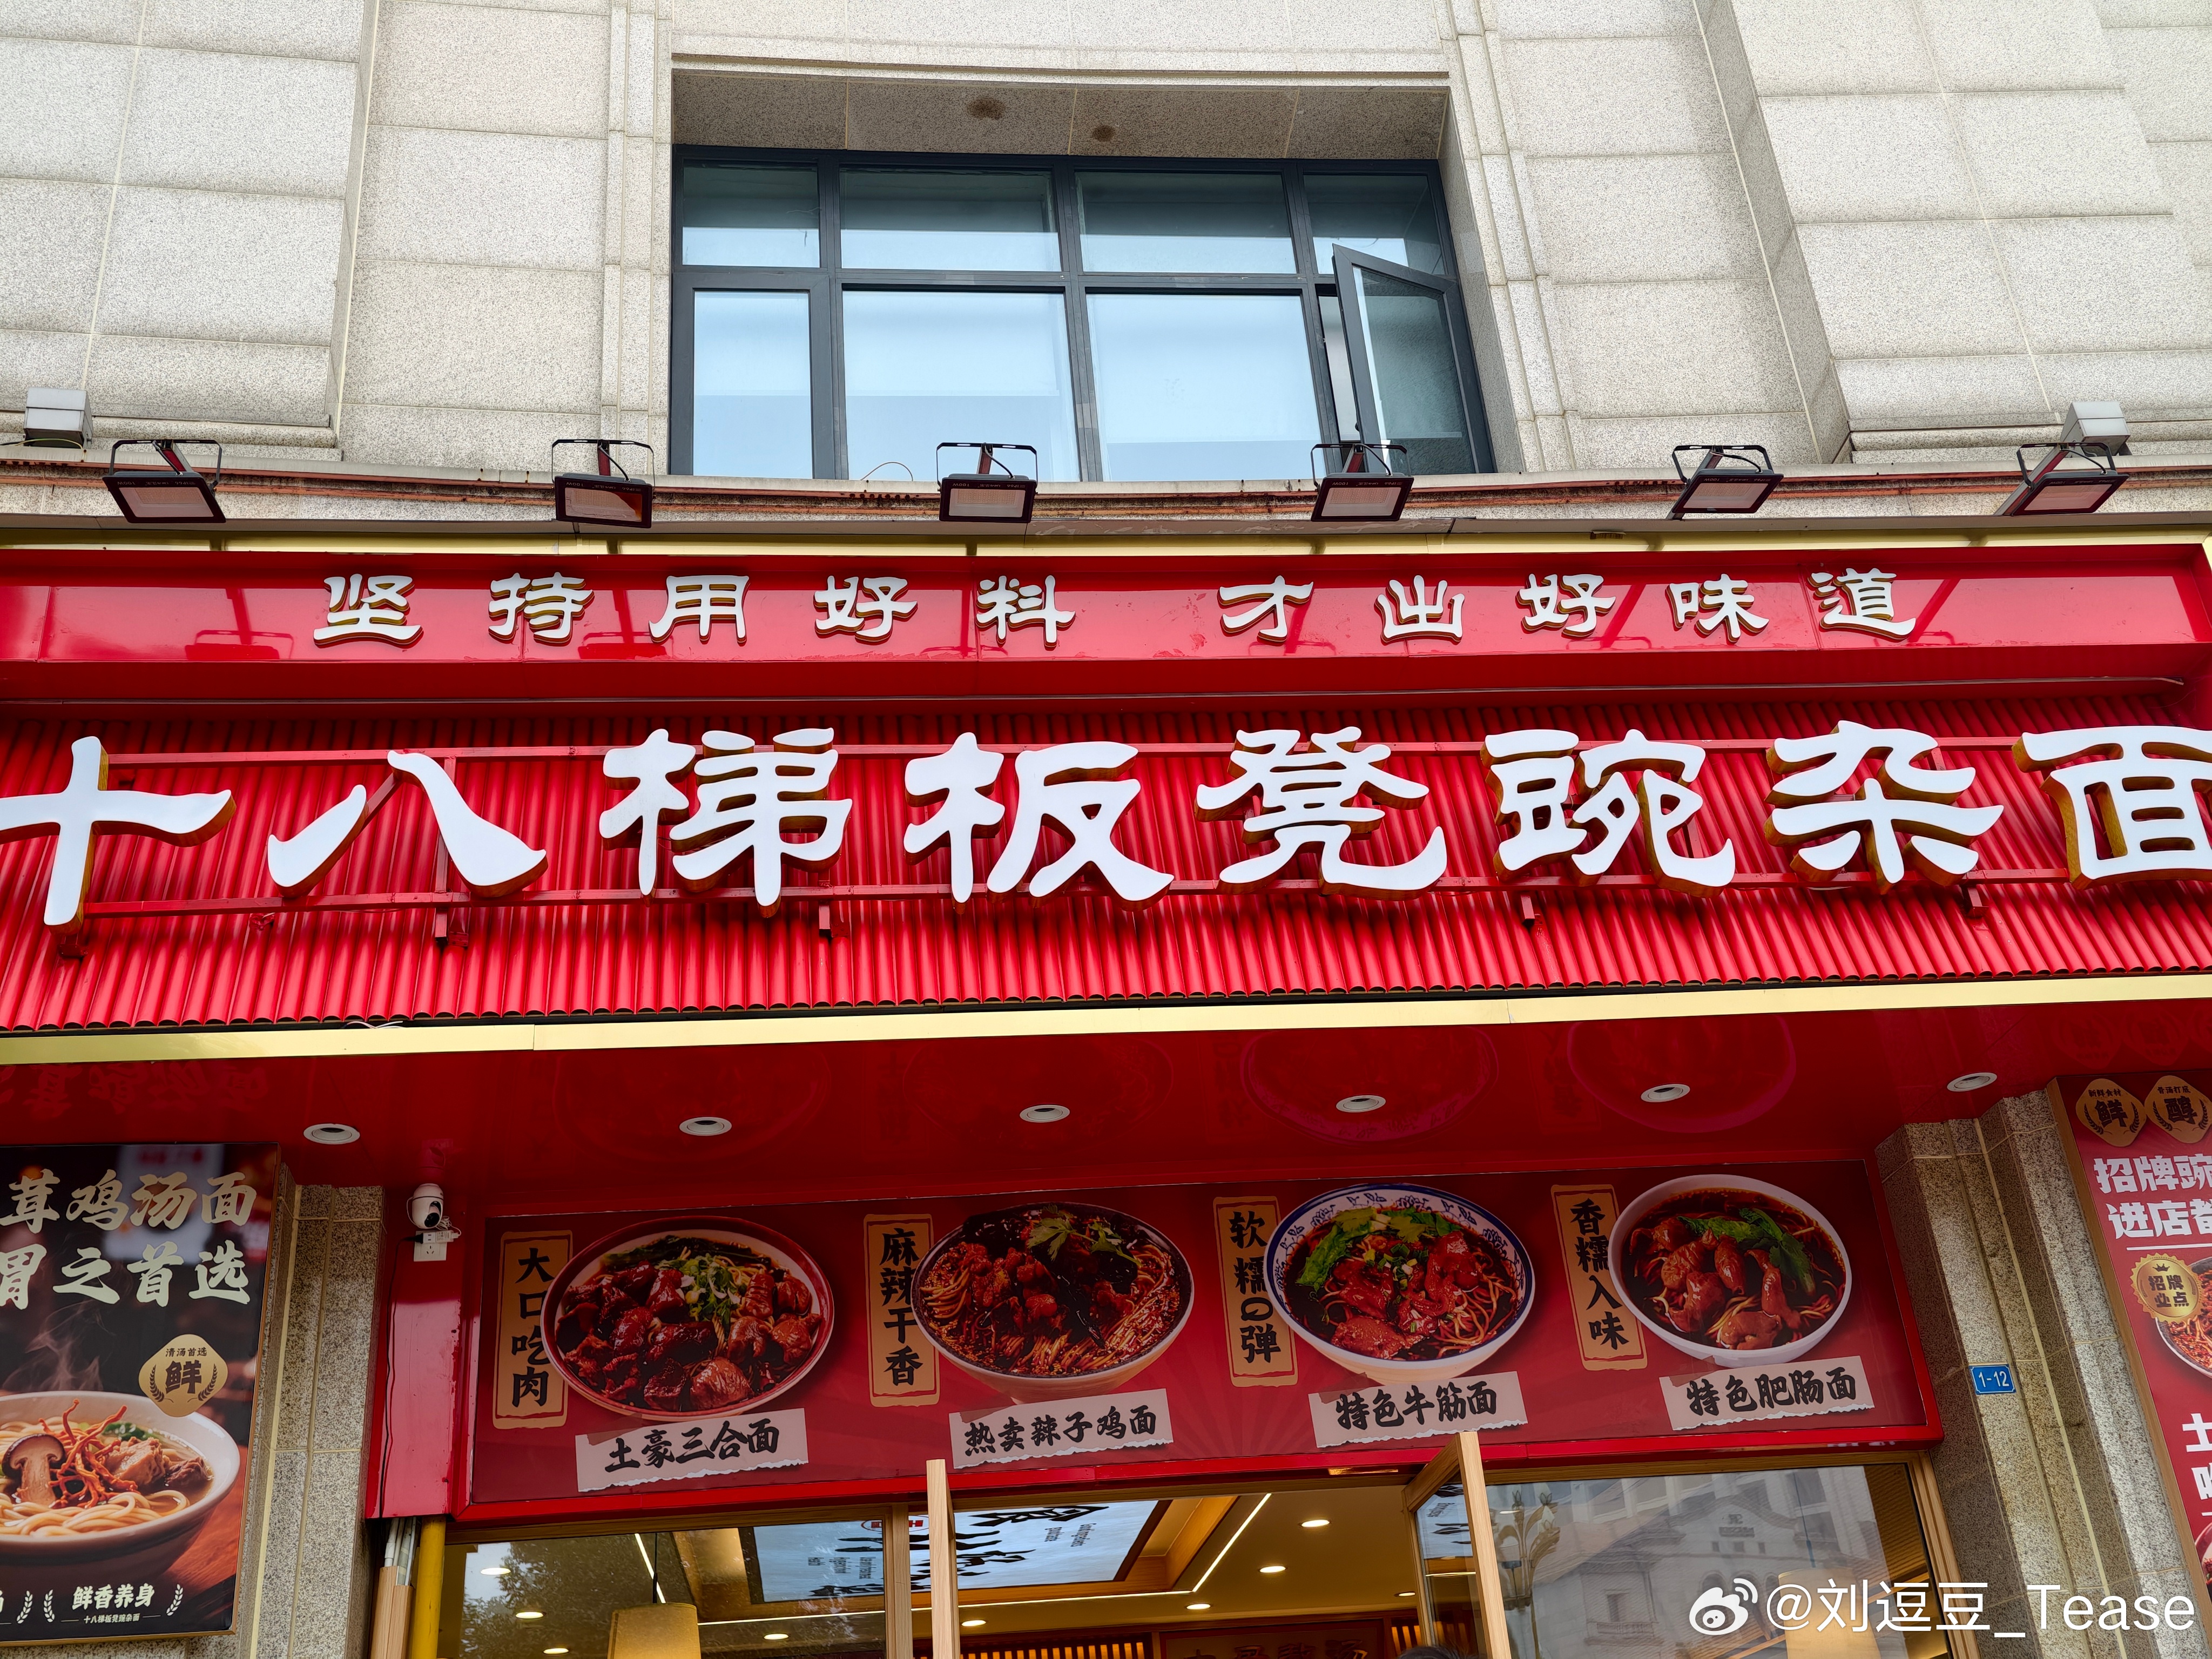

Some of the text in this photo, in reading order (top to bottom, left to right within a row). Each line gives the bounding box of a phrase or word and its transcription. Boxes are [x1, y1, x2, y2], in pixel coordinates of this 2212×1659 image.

[313, 566, 1917, 648] 坚持用好料 才出好味道
[0, 720, 2212, 930] 十八梯板凳豌杂面
[2088, 1088, 2122, 1098] 新鲜食材
[2157, 1085, 2191, 1095] 骨汤打底
[2163, 1095, 2198, 1125] 醇
[2094, 1098, 2128, 1128] 鲜
[1228, 1210, 1282, 1364] 软糯Q弹
[1570, 1197, 1630, 1351] 香糯入味
[2148, 1274, 2184, 1291] 招牌
[511, 1246, 555, 1408] 大口吃肉
[879, 1228, 923, 1387] 麻辣干香
[165, 1346, 207, 1358] 清汤首选
[165, 1359, 202, 1394] 鲜
[1685, 1366, 1857, 1417] 特色肥肠面
[1979, 1370, 2011, 1390] 1-12
[1334, 1380, 1498, 1431] 特色牛筋面
[604, 1418, 780, 1473] 土豪三合面
[964, 1405, 1157, 1456] 热卖辣子鸡面
[71, 1582, 155, 1610] 鲜香养身
[84, 1613, 140, 1624] 十八梯板凳豌杂面
